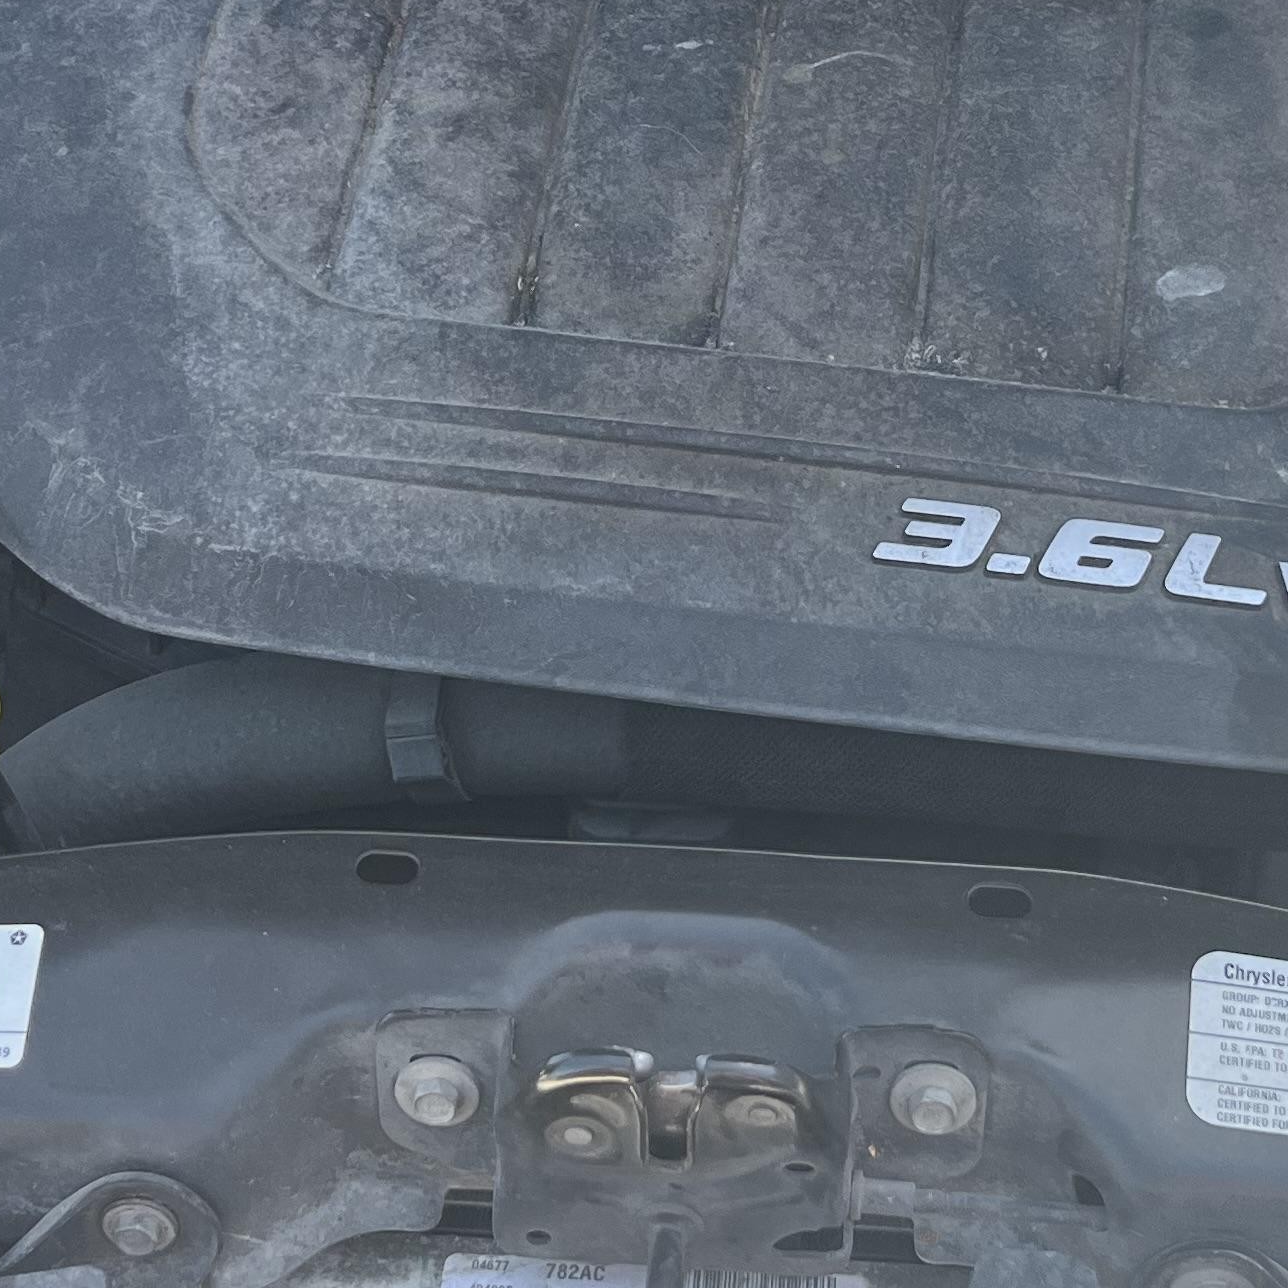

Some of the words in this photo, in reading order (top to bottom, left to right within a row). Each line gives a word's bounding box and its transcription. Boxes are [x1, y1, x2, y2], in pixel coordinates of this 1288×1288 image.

[871, 496, 1268, 606] 3.6L
[1224, 962, 1288, 987] Chrysle
[1222, 1004, 1236, 1015] NO
[1239, 1007, 1288, 1023] ADJUSTM
[1222, 1018, 1243, 1031] TWC
[1220, 1041, 1240, 1053] U.S.
[1219, 1054, 1271, 1071] CERTIFIED
[1275, 1062, 1288, 1072] TO
[1218, 1084, 1281, 1103] CALIFORNIA:
[1217, 1098, 1269, 1114] CERTIFIED
[1274, 1105, 1287, 1116] TO
[1216, 1111, 1269, 1127] CERTIFIED
[545, 1262, 606, 1281] 782AC
